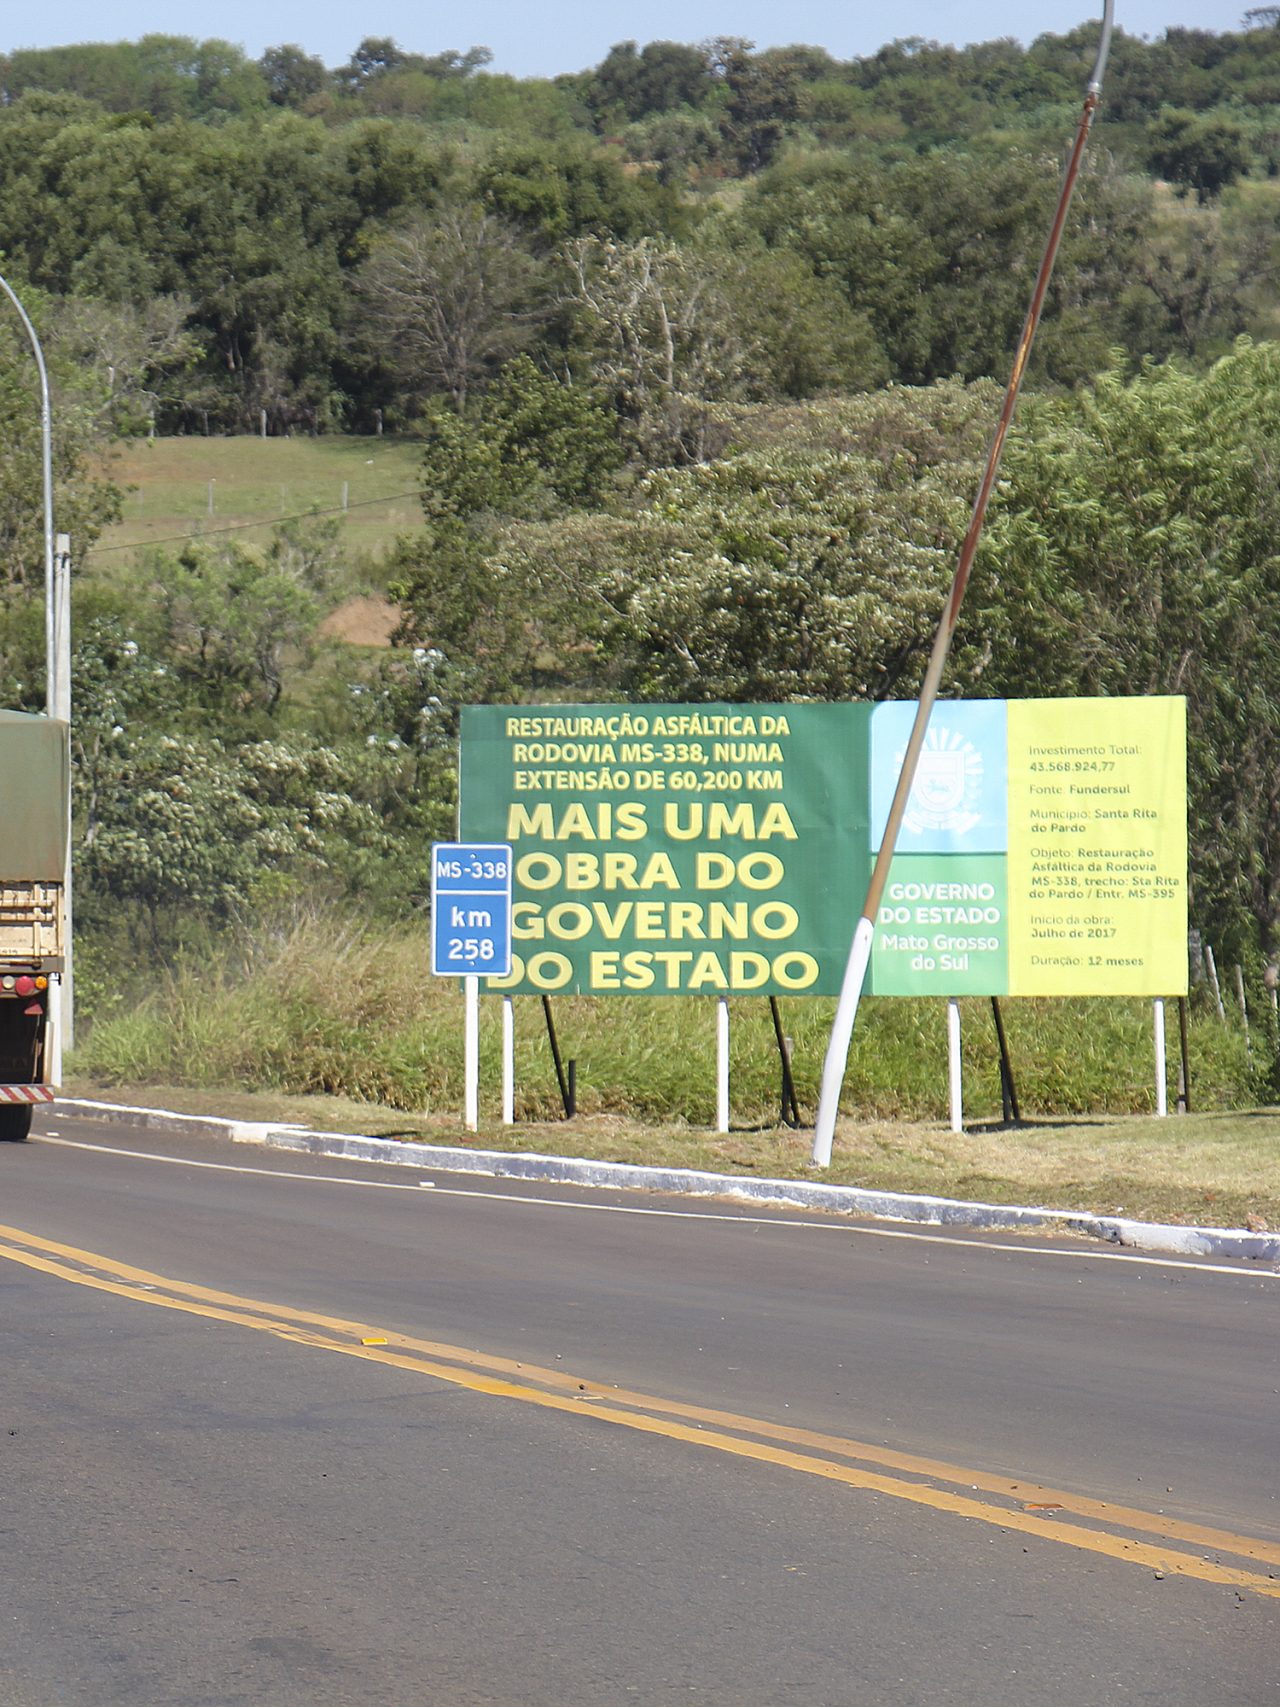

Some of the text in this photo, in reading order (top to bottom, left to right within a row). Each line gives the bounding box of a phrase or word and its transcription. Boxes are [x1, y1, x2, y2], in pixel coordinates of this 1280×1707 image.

[506, 712, 791, 741] RESTAURAÇÃO ASFÁLTICA DA
[514, 743, 785, 766] RODOVIA MS-338, NUMA
[1029, 745, 1142, 756] Investimento Total:
[1029, 761, 1116, 773] 43.568.924,77
[515, 767, 783, 793] EXTENSÃO DE 60,200 KM
[1069, 784, 1131, 795] Fundersul
[506, 802, 799, 840] MAIS UMA
[1094, 808, 1129, 819] Santa
[1133, 808, 1158, 819] Rita
[1031, 823, 1087, 833] do Pardo
[1078, 848, 1155, 860] Restauração
[437, 860, 508, 879] MS-338
[516, 852, 785, 890] OBRA DO
[1087, 861, 1102, 872] da
[1106, 862, 1158, 872] Rodovia
[1132, 876, 1152, 886] Sta
[1155, 875, 1180, 886] Rita
[889, 882, 995, 901] GOVERNO
[1029, 889, 1045, 899] do
[1048, 889, 1084, 899] Pardo
[1128, 889, 1175, 899] MS-395
[451, 906, 492, 928] km
[511, 902, 800, 940] GOVERNO
[880, 906, 1001, 924] DO ESTADO
[1066, 915, 1080, 925] da
[1031, 928, 1118, 938] Julho de 2017
[448, 938, 495, 961] 258
[881, 934, 1000, 951] Mato Grosso
[911, 953, 969, 971] do Sul
[1088, 957, 1103, 966] 12
[1106, 958, 1145, 966] meses
[590, 951, 820, 990] ESTADO
